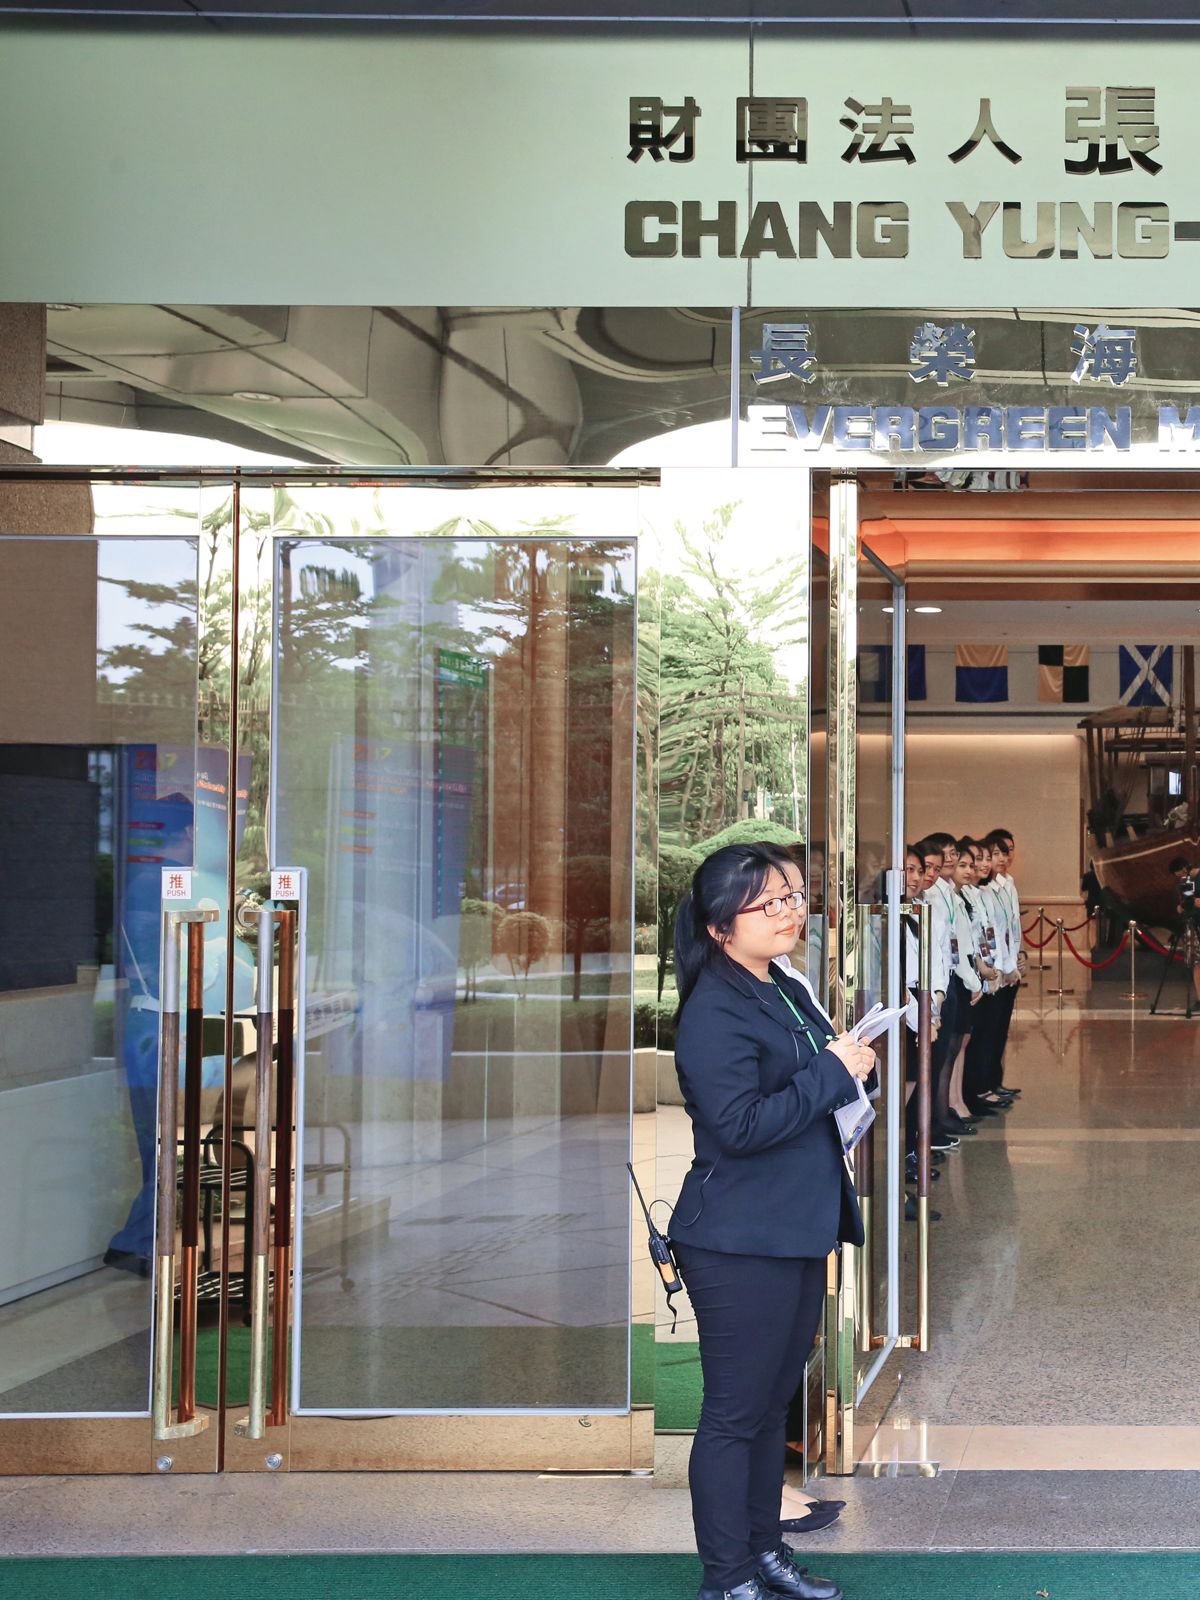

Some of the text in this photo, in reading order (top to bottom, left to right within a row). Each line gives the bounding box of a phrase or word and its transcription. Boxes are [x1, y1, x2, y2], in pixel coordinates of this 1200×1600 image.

[624, 200, 911, 260] CHANG
[747, 405, 1132, 453] EVERGREEN
[169, 873, 184, 889] 推
[277, 874, 292, 890] 推
[166, 889, 187, 898] PUSH
[275, 889, 295, 898] PUSH
